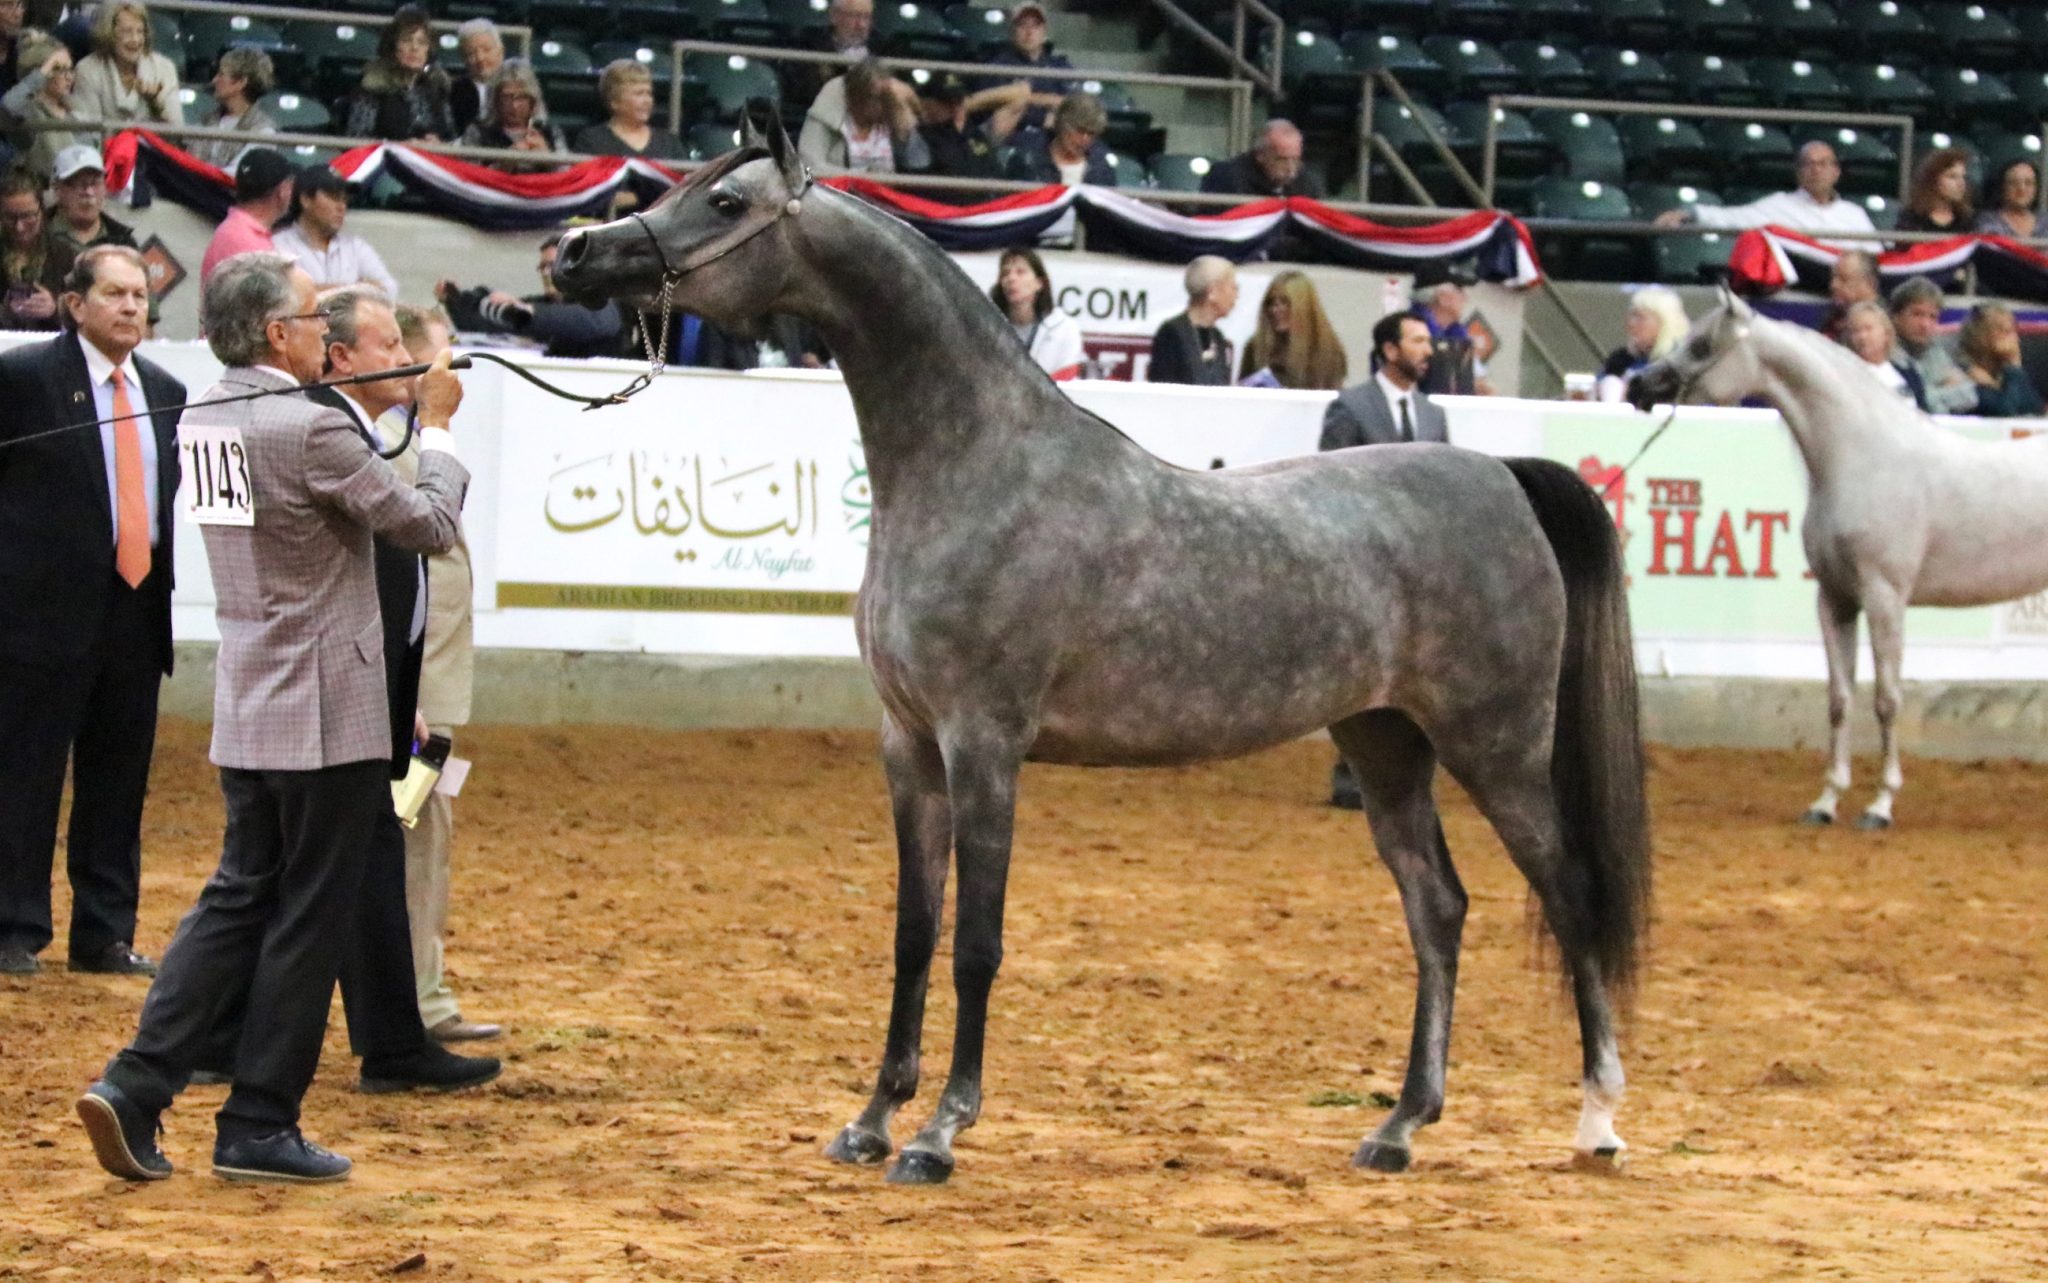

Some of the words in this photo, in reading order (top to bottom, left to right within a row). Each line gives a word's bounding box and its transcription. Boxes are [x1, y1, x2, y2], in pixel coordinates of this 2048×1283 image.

[192, 440, 250, 509] 1143
[1646, 478, 1702, 505] THE
[711, 547, 742, 570] Al
[1647, 508, 1789, 578] HAT
